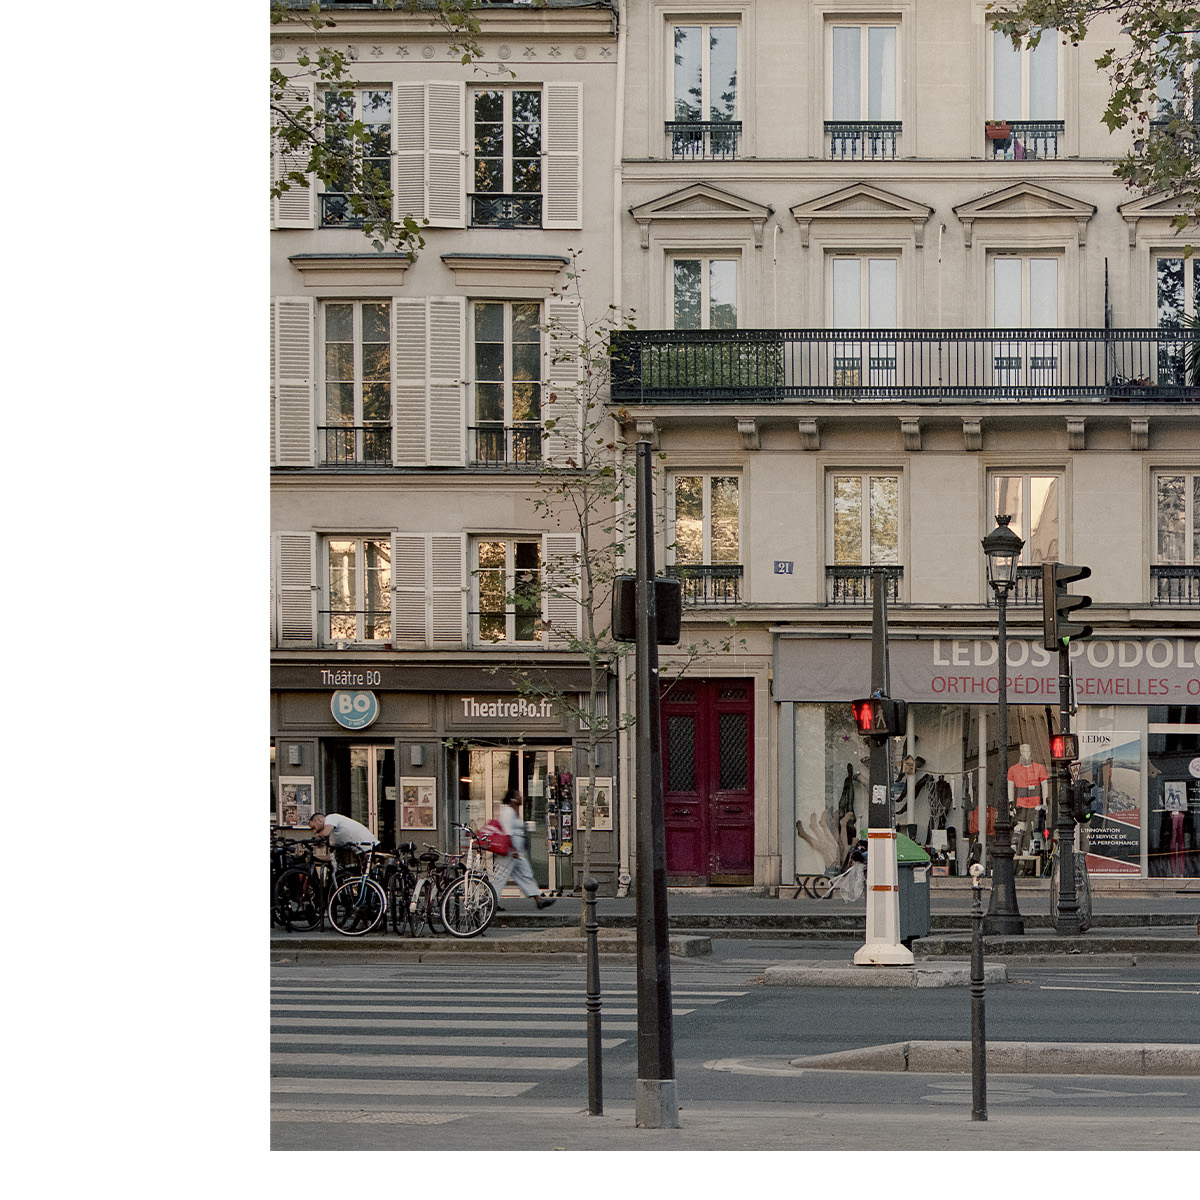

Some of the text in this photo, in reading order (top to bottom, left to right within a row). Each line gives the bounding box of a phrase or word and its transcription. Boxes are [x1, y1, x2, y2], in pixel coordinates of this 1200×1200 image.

[778, 562, 789, 573] 21
[933, 639, 1051, 667] LEDOS
[320, 669, 381, 686] Théâtre BO
[1075, 678, 1169, 695] SEMELLES
[339, 694, 371, 714] BO
[461, 697, 553, 718] TheatreBo.fr
[1082, 735, 1111, 743] LEDOS
